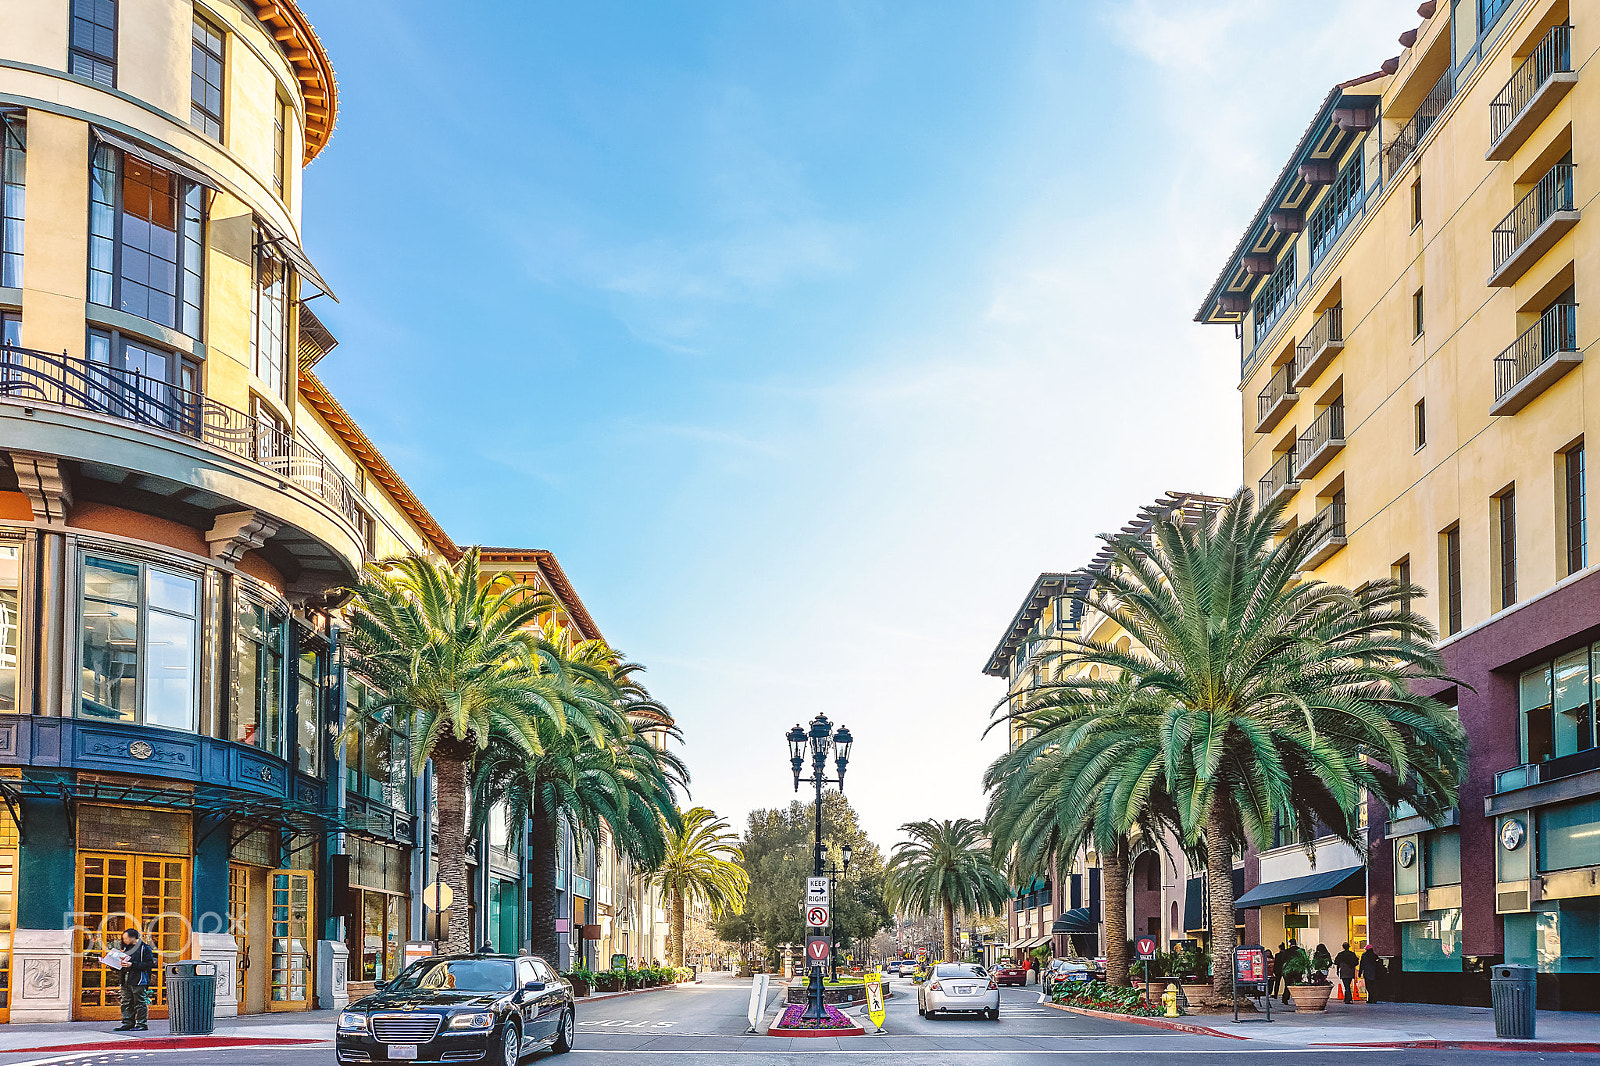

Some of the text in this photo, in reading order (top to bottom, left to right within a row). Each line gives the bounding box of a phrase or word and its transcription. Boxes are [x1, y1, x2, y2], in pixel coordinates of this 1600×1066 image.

[812, 944, 824, 958] V
[1140, 941, 1151, 953] V
[577, 1020, 679, 1028] STOP
